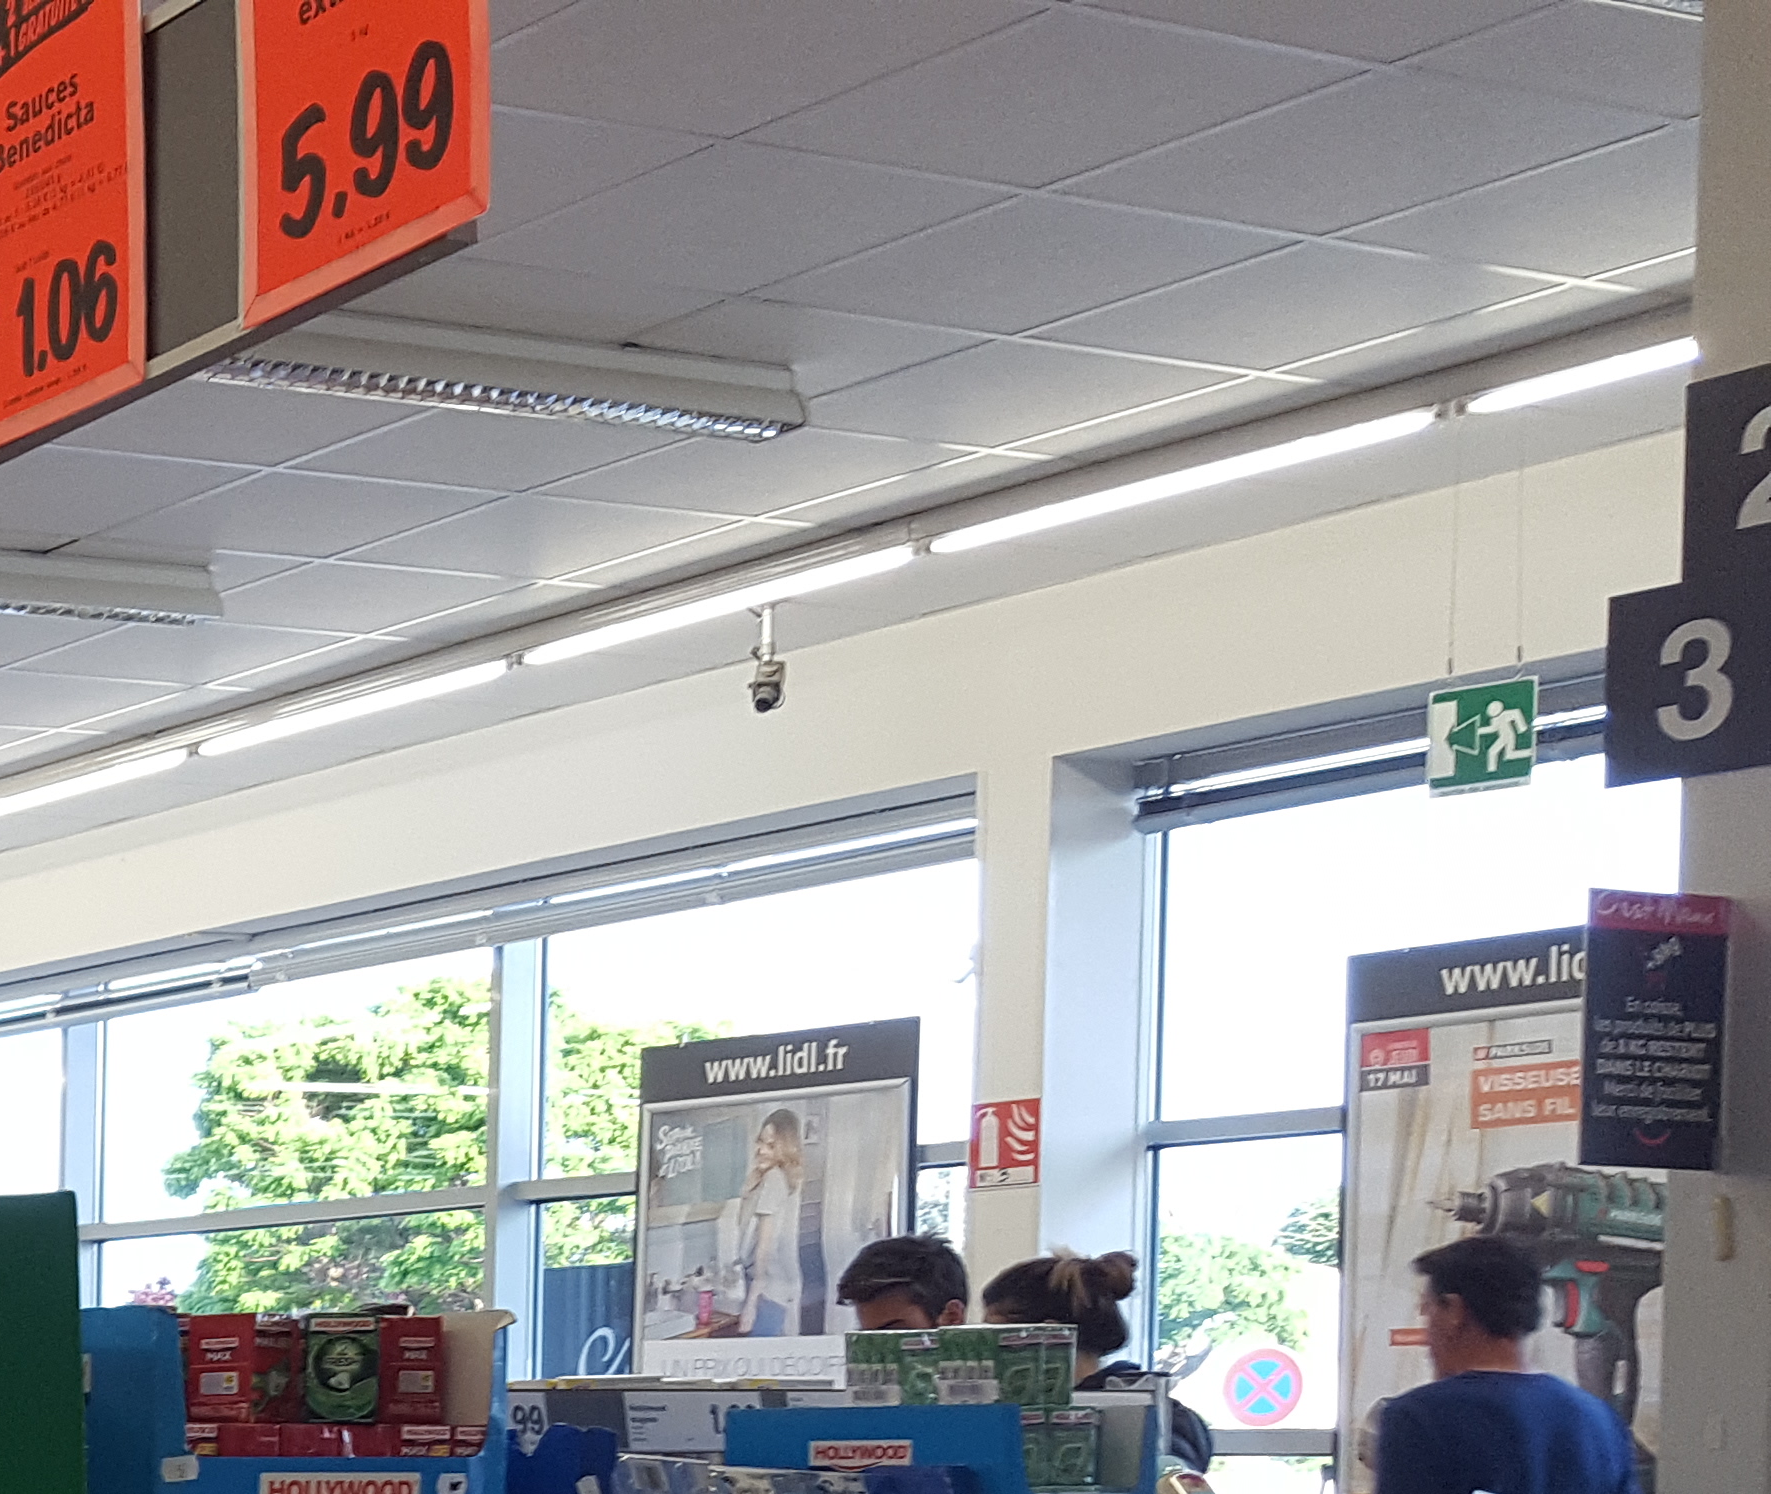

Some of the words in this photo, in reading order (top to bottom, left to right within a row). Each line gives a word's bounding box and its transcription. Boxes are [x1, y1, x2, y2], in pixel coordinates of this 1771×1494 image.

[5, 72, 79, 133] Sauces
[279, 39, 455, 240] 5.99
[17, 239, 119, 378] 1.06
[1657, 617, 1734, 741] 3
[704, 1037, 849, 1085] www.lidl.fr
[1477, 1065, 1581, 1094] VISSEUSE
[1477, 1103, 1537, 1122] SANS
[813, 1443, 909, 1461] HOLLYWOOD
